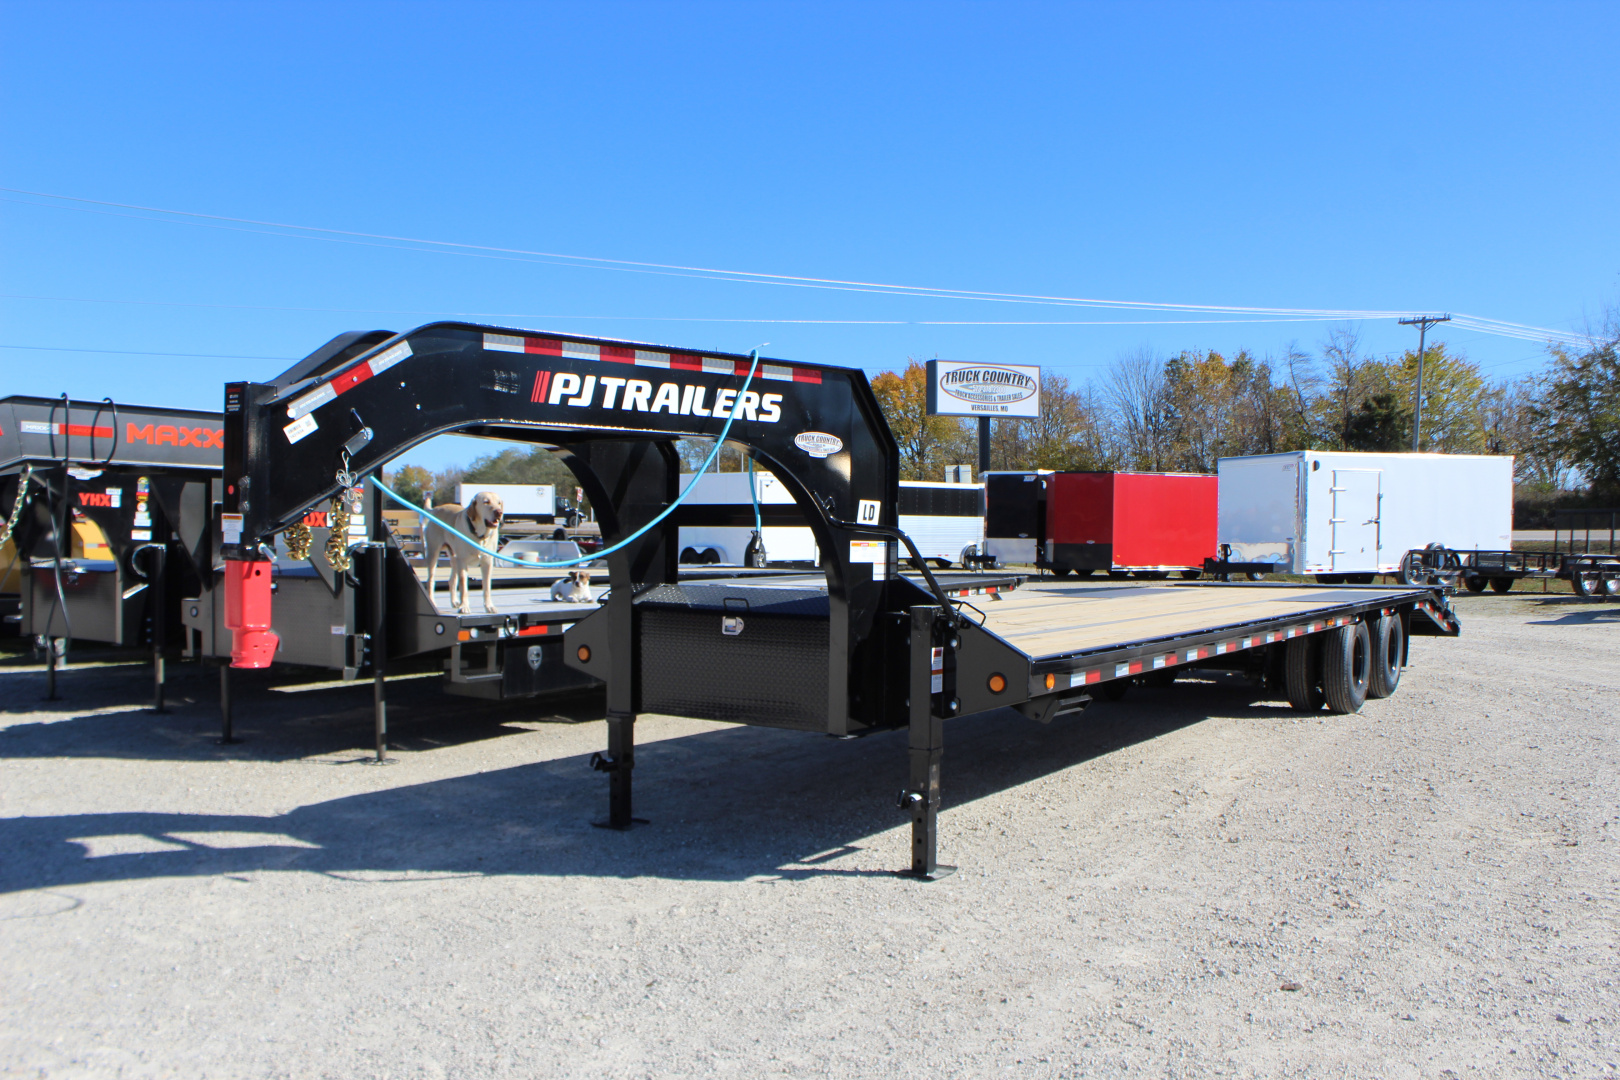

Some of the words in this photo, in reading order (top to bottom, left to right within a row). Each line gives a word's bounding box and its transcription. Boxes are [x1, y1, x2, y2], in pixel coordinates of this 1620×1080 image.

[945, 370, 980, 384] TRUCK
[982, 370, 1031, 386] COUNTRY
[955, 389, 968, 399] TRUCK
[862, 503, 876, 522] LD
